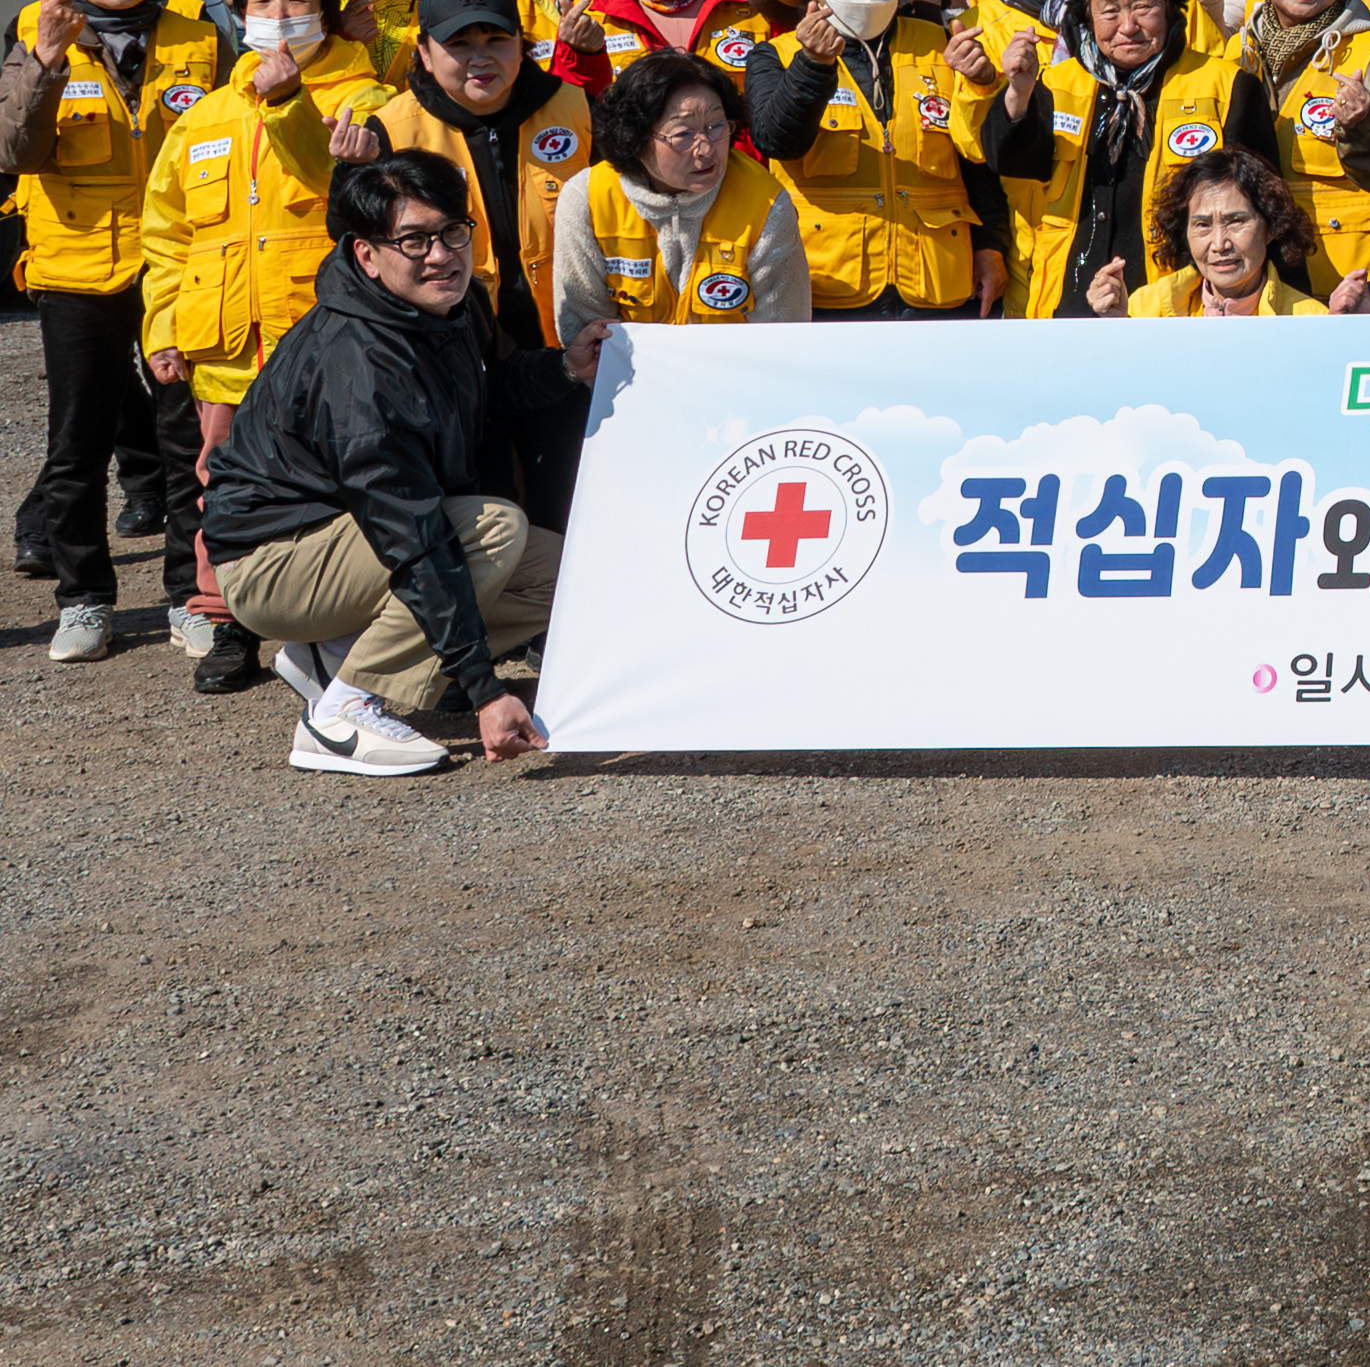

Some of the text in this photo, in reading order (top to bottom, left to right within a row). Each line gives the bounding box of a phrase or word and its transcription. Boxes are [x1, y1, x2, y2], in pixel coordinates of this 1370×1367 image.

[699, 440, 876, 526] KOREAN RED CROSS
[711, 565, 849, 615] 대한적십자사
